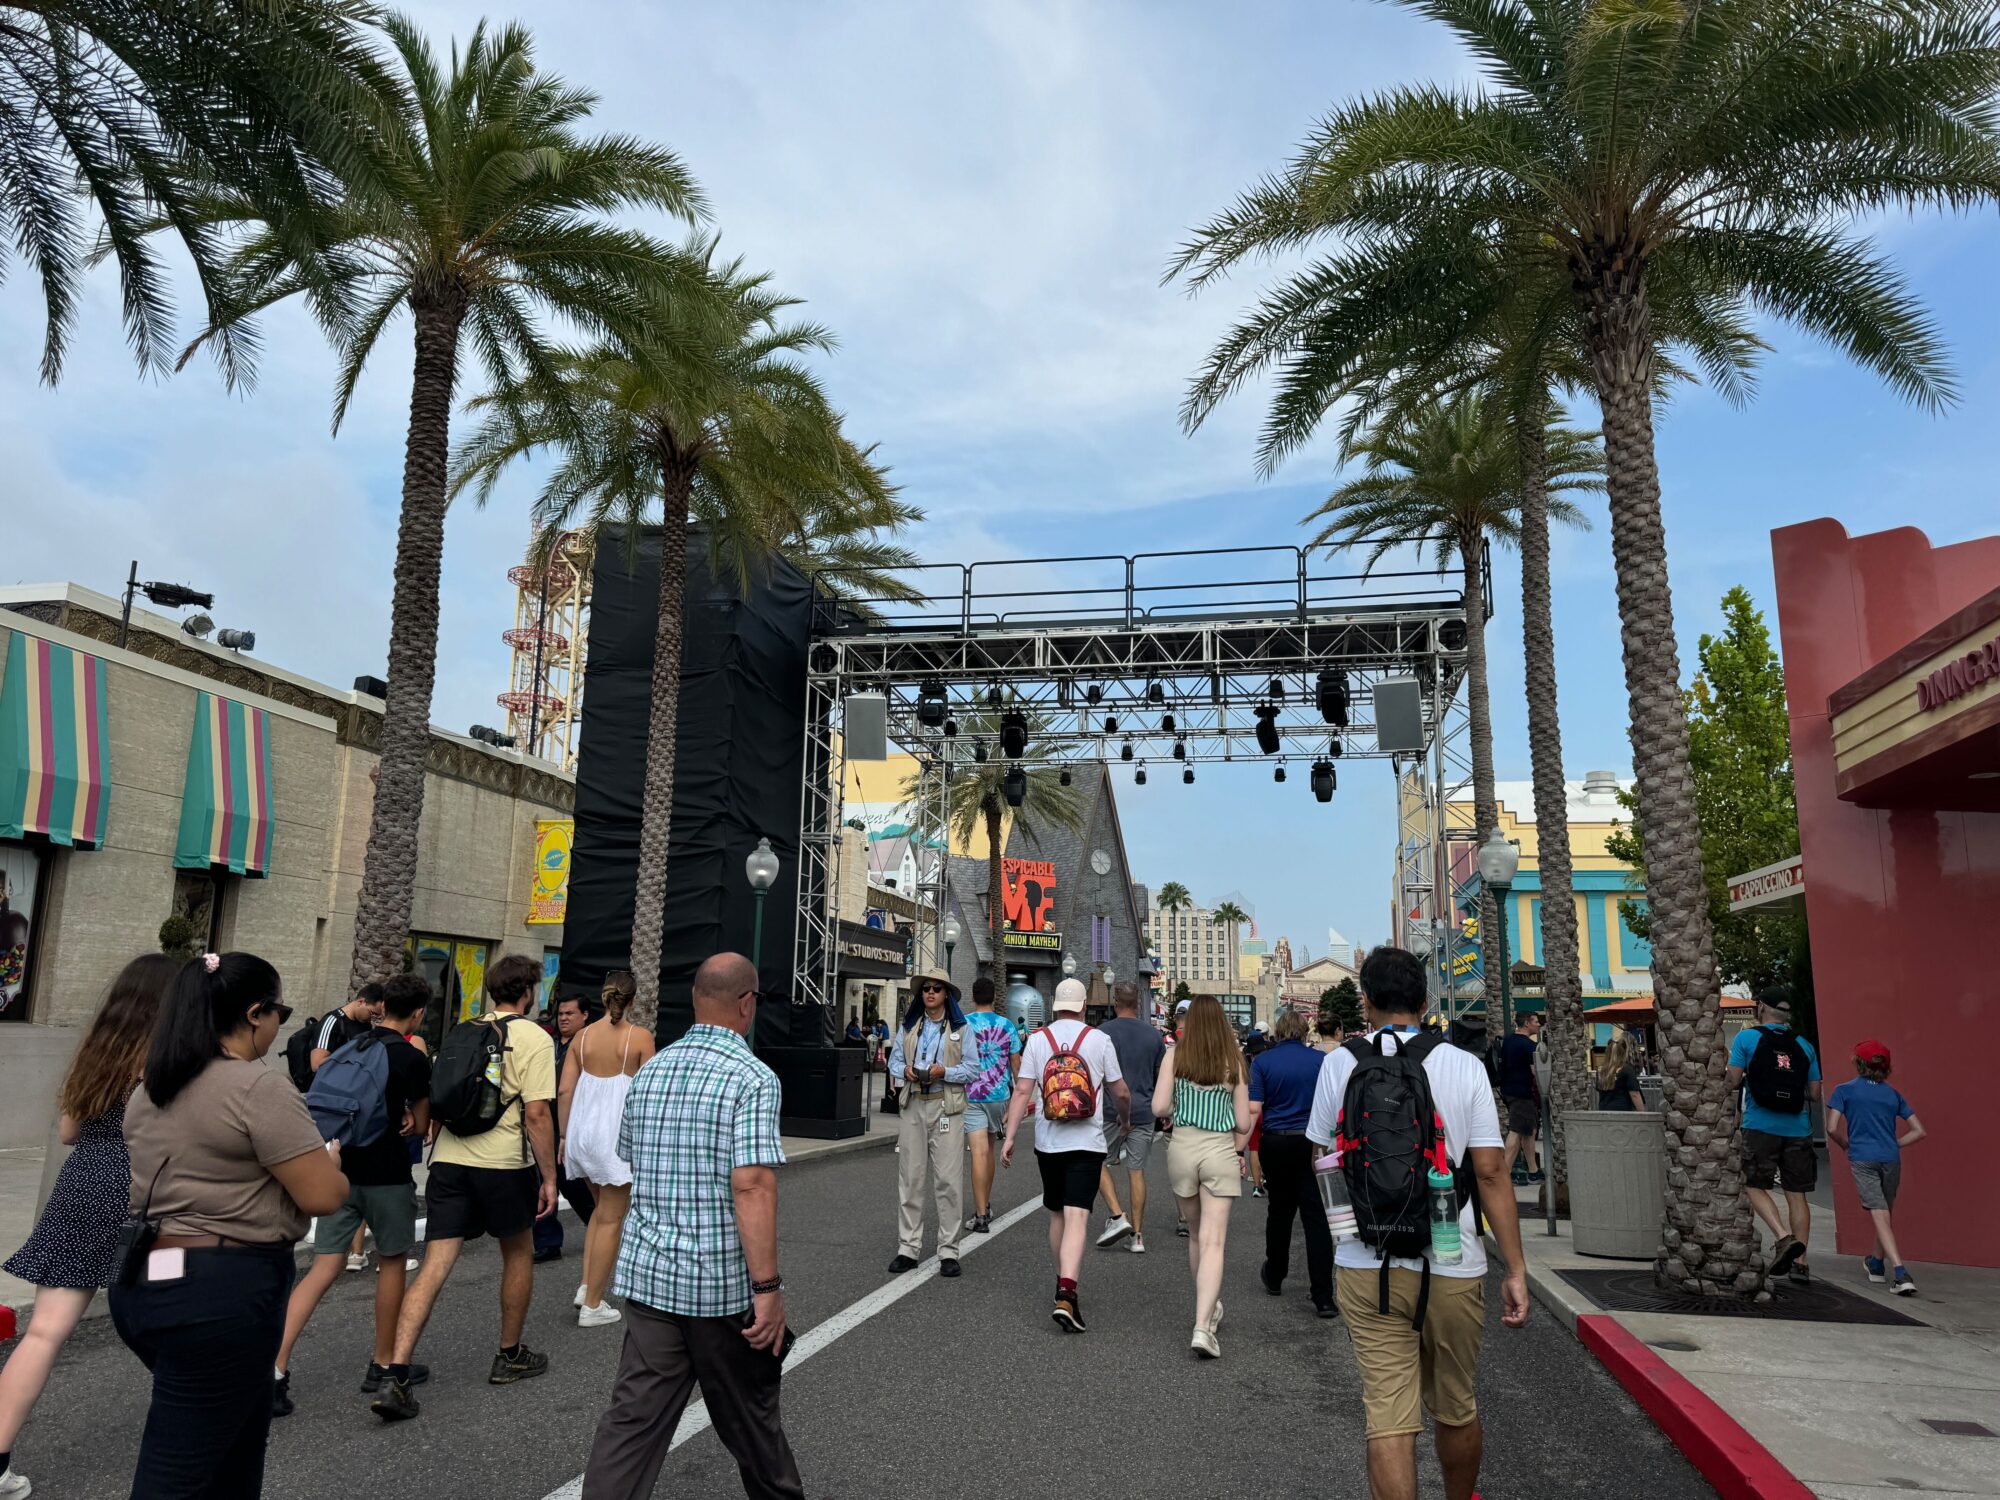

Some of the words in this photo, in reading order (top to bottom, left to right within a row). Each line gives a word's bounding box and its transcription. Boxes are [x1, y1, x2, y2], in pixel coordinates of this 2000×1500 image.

[1916, 651, 1984, 712] DINING
[1001, 858, 1056, 876] ESPICABLE
[1738, 868, 1793, 900] CAPPUCCINO
[1029, 936, 1058, 948] MAYHEM
[852, 943, 882, 960] STUDIOS
[883, 949, 904, 964] STORE
